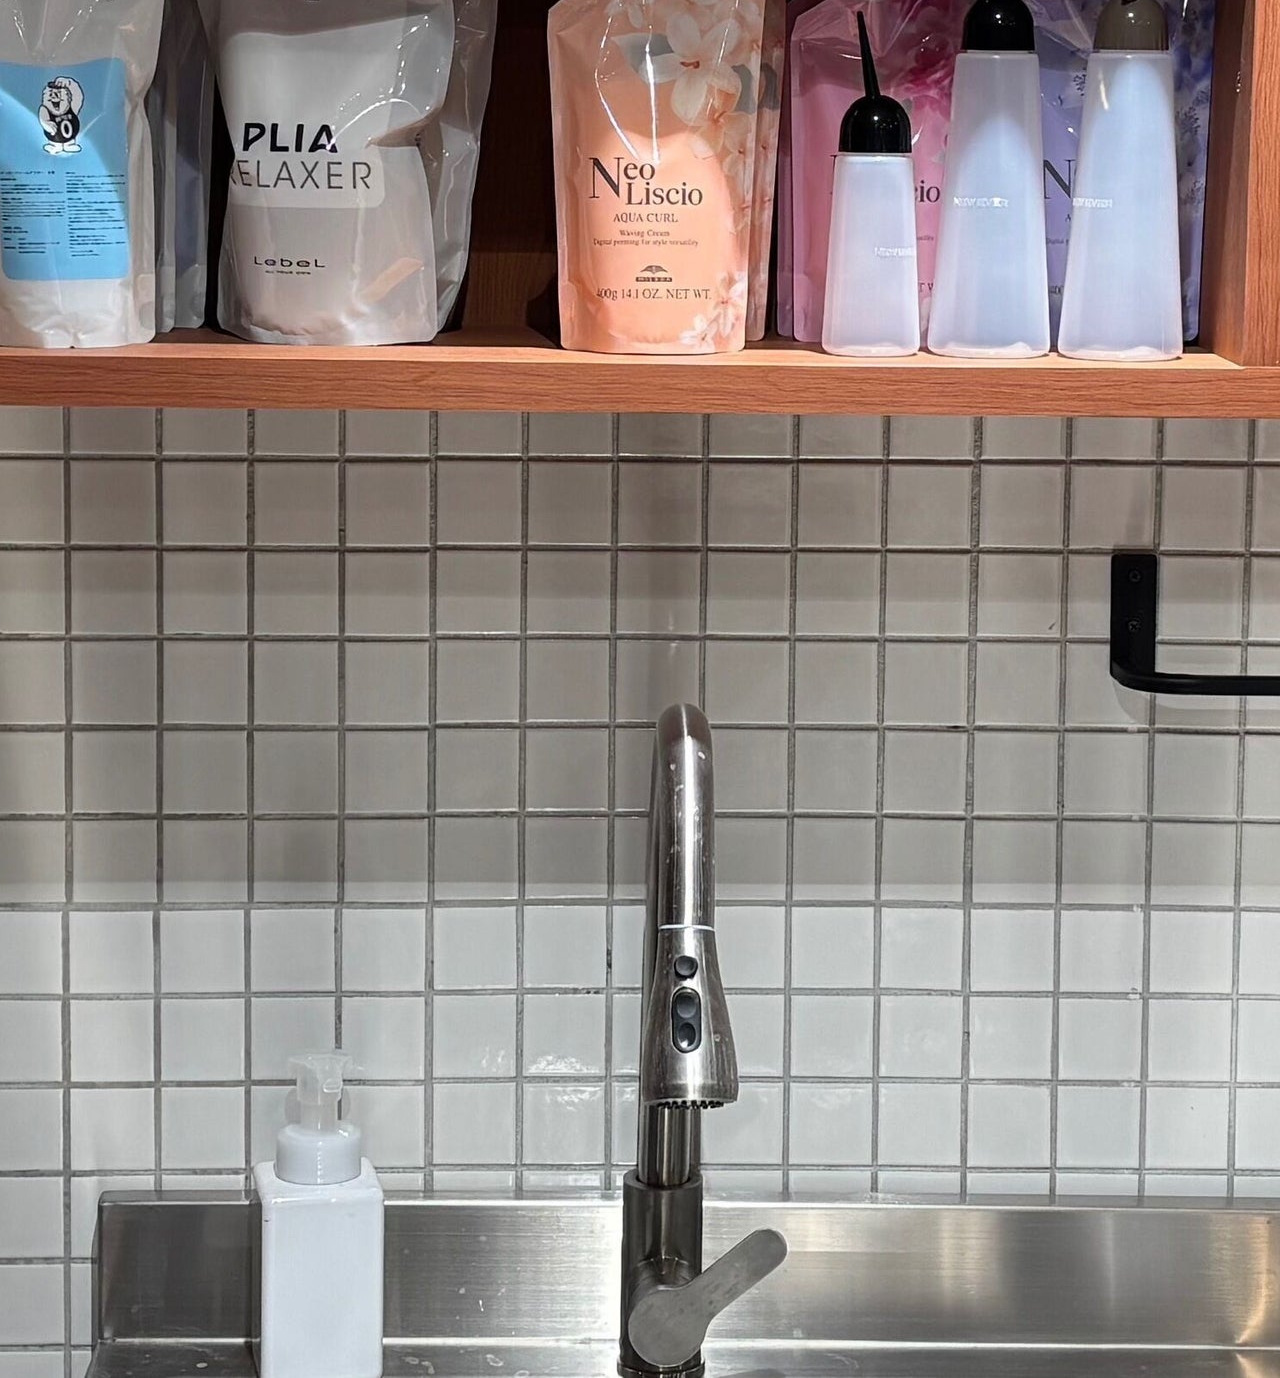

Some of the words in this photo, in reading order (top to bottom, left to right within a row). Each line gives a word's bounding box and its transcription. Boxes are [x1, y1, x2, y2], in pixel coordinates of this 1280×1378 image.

[242, 123, 338, 153] PLIA
[230, 160, 372, 190] RELAXER
[588, 157, 655, 199] Neo
[625, 182, 703, 205] Liscio
[613, 213, 643, 223] AQUA
[647, 213, 678, 222] CURL
[666, 289, 690, 299] NET
